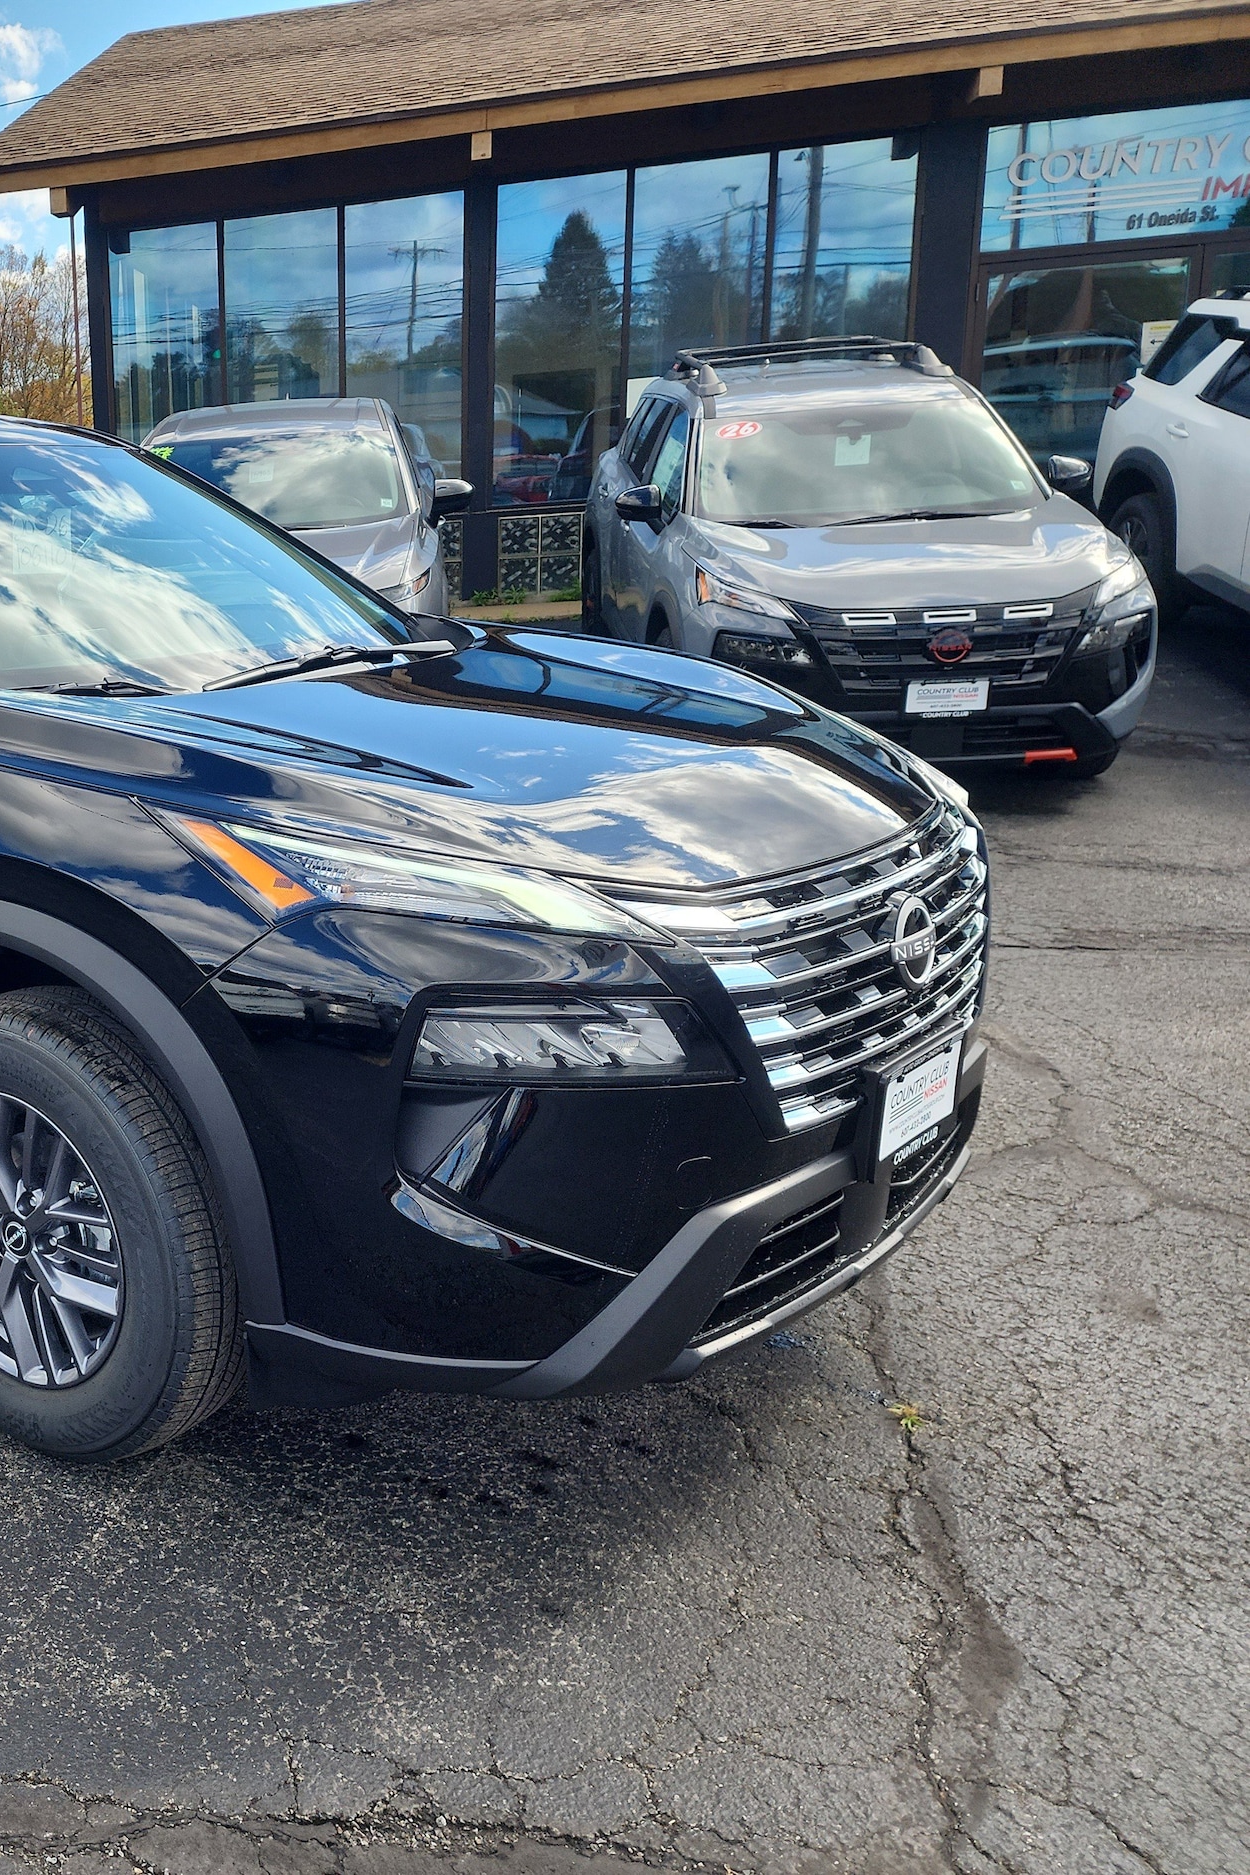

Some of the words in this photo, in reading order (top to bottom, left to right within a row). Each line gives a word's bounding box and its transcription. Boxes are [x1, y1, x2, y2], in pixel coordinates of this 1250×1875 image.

[1007, 133, 1233, 188] COUNTRY
[1125, 213, 1143, 231] 61
[1147, 208, 1197, 228] Oneida
[1199, 205, 1219, 223] St.
[725, 422, 756, 439] 26
[929, 643, 973, 651] NISSAN
[895, 934, 935, 960] NISS
[890, 1073, 930, 1109] COUNTRY
[930, 1060, 950, 1084] CLUB
[923, 1078, 948, 1100] NISSAN
[893, 1134, 923, 1166] COUNTRY
[922, 1126, 939, 1147] CLUB
